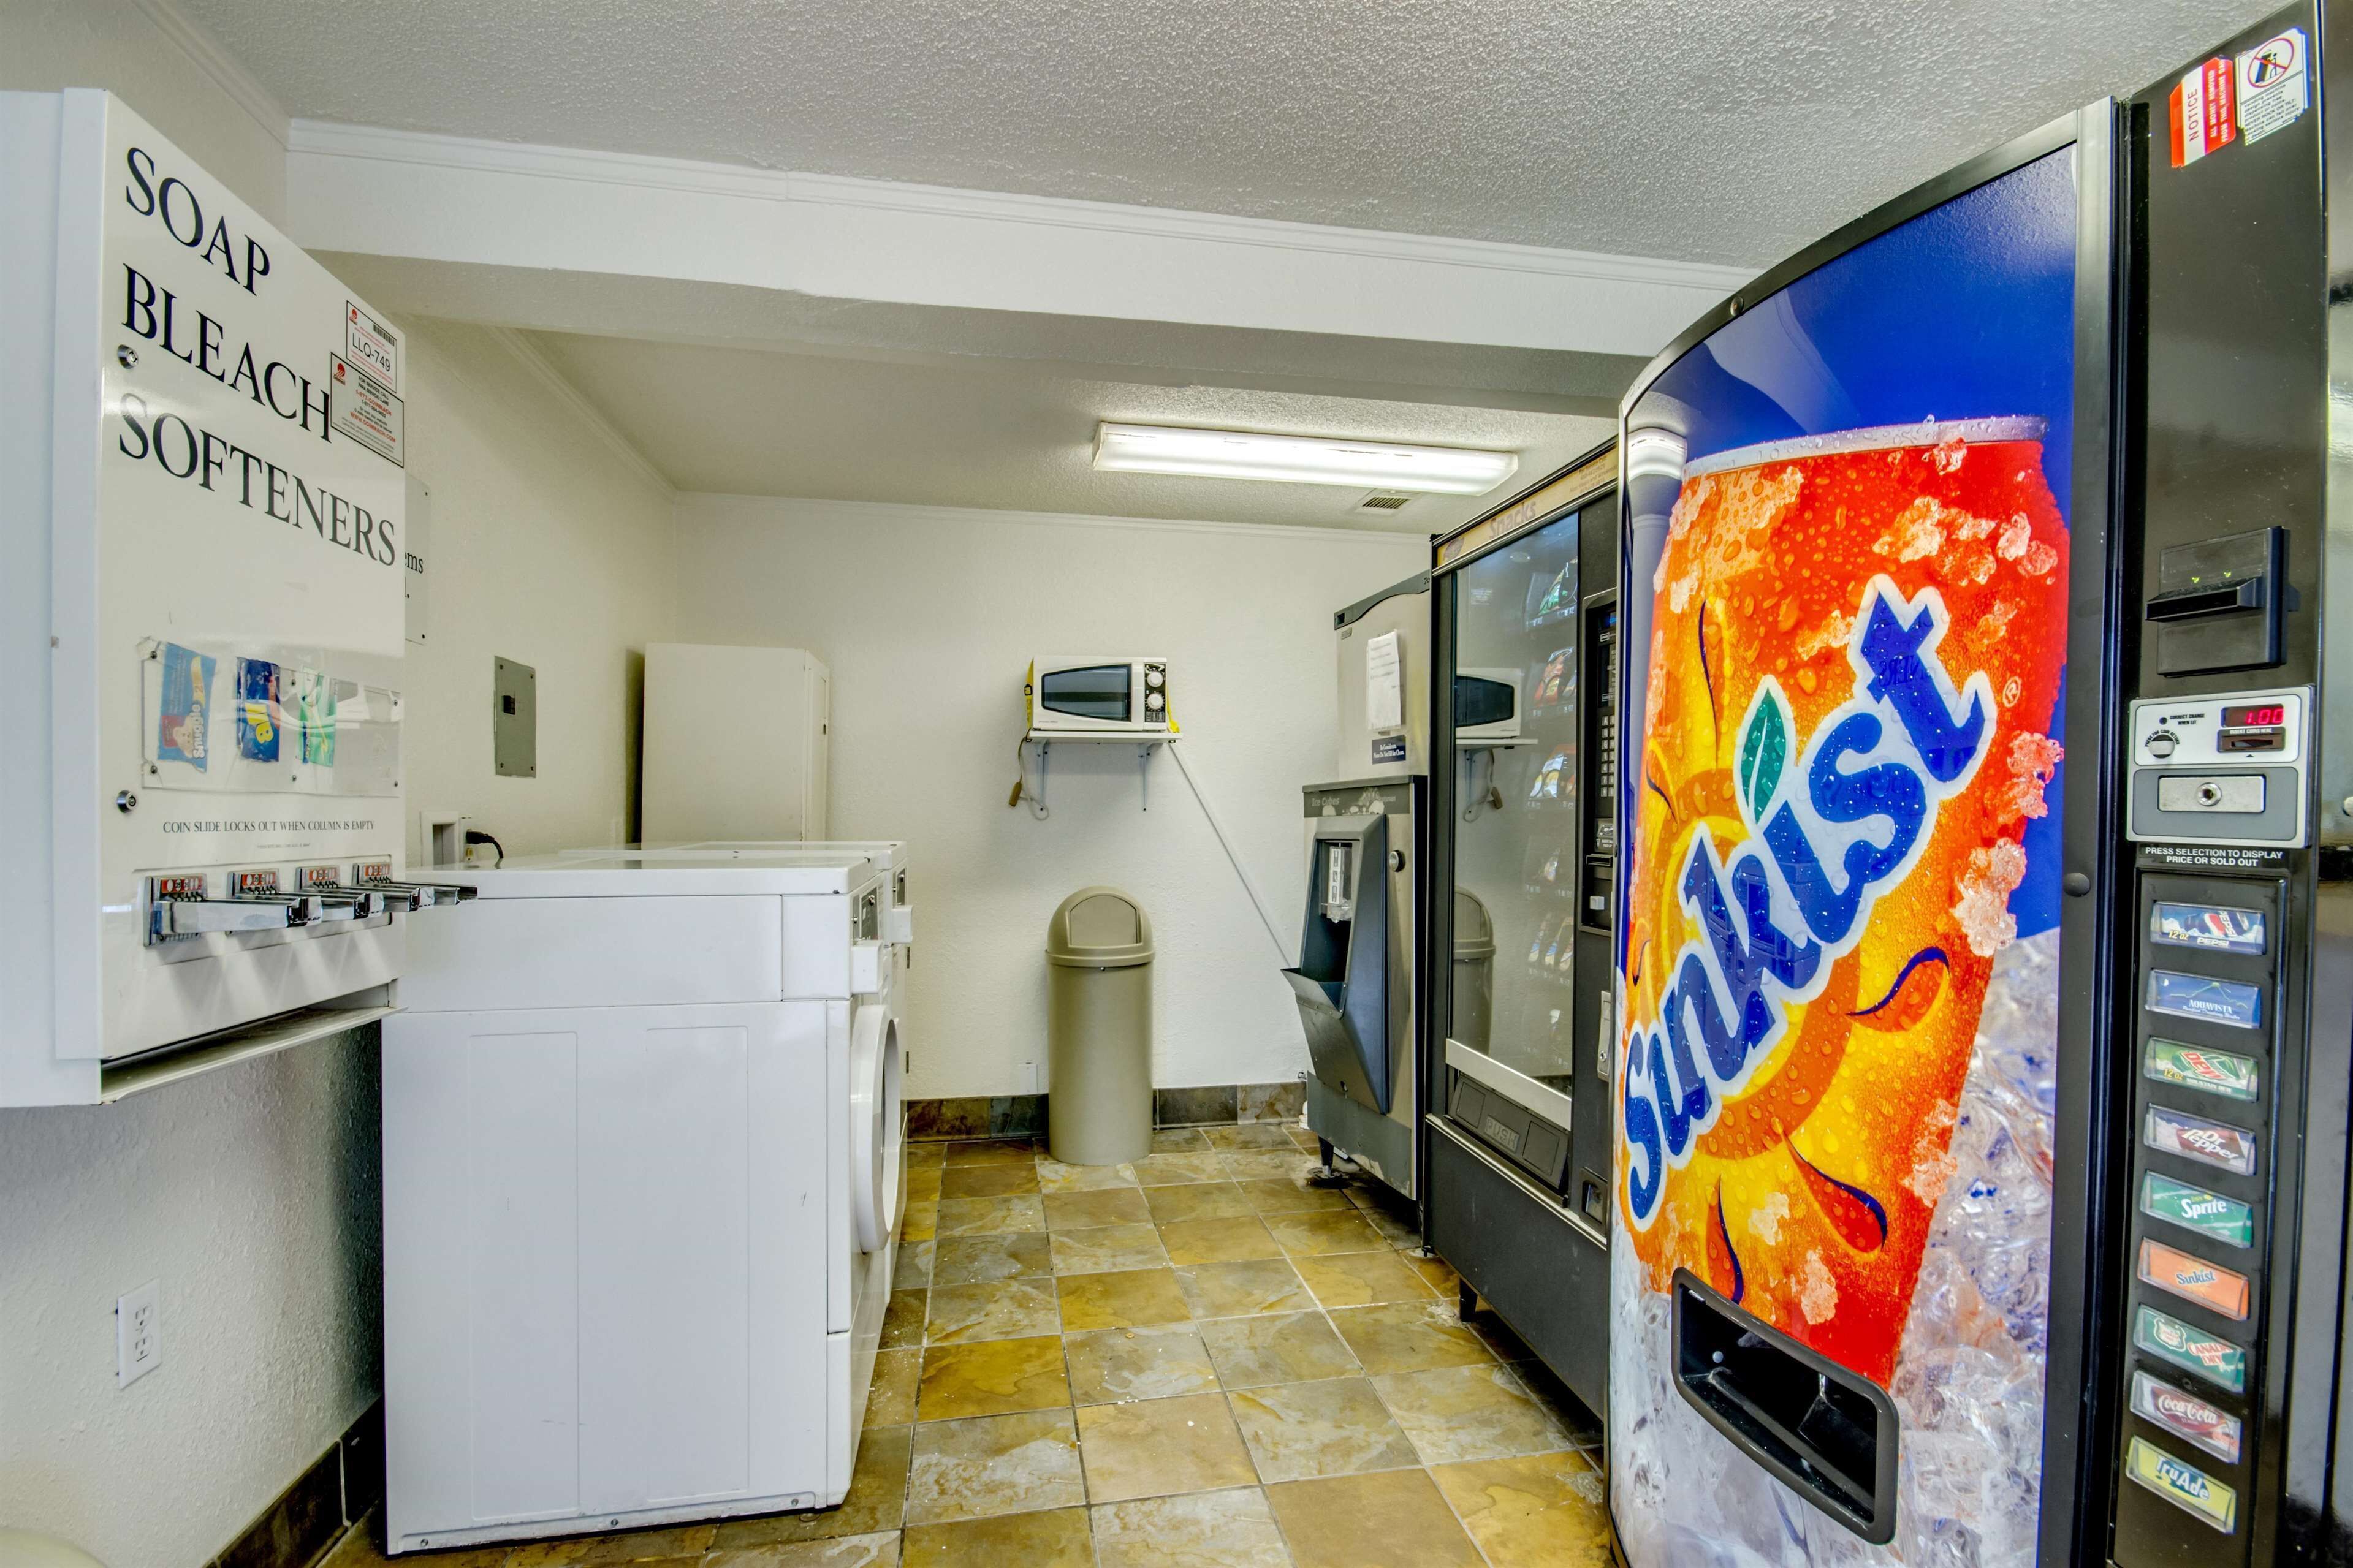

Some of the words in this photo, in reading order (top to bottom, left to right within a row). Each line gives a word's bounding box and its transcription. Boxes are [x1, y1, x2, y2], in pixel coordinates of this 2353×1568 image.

[2188, 89, 2199, 142] NOTICE
[126, 148, 270, 297] SOAP
[121, 263, 332, 443] BLEACH
[119, 392, 396, 567] SOFTENERS
[1489, 501, 1537, 539] Snacks
[2246, 708, 2284, 725] 1.00
[191, 703, 205, 759] Snuggle
[1312, 798, 1321, 807] Ice
[1321, 797, 1339, 806] Cubes
[163, 822, 191, 834] COIN
[193, 822, 221, 833] SLIDE
[224, 821, 256, 832] LOCKS
[258, 821, 277, 831] OUT
[279, 820, 306, 831] WHEN
[308, 820, 341, 831] COLUMN
[343, 820, 350, 830] IS
[351, 820, 375, 830] EMPTY
[2175, 849, 2226, 857] SELECTION
[2242, 850, 2283, 859] DISPLAY
[2210, 857, 2236, 866] SOLD
[1626, 581, 1992, 1225] Sunkist
[2169, 930, 2180, 940] 12
[2180, 933, 2189, 941] oz
[2196, 937, 2230, 949] PEPSI
[2164, 1069, 2173, 1078] 12
[1486, 1118, 1516, 1149] PUSH
[2200, 1131, 2226, 1146] Dr
[2181, 1129, 2240, 1159] Pepper
[2181, 1199, 2227, 1219] Sprite
[2176, 1270, 2216, 1285] Sunkist
[2156, 1456, 2210, 1501] TruAde
